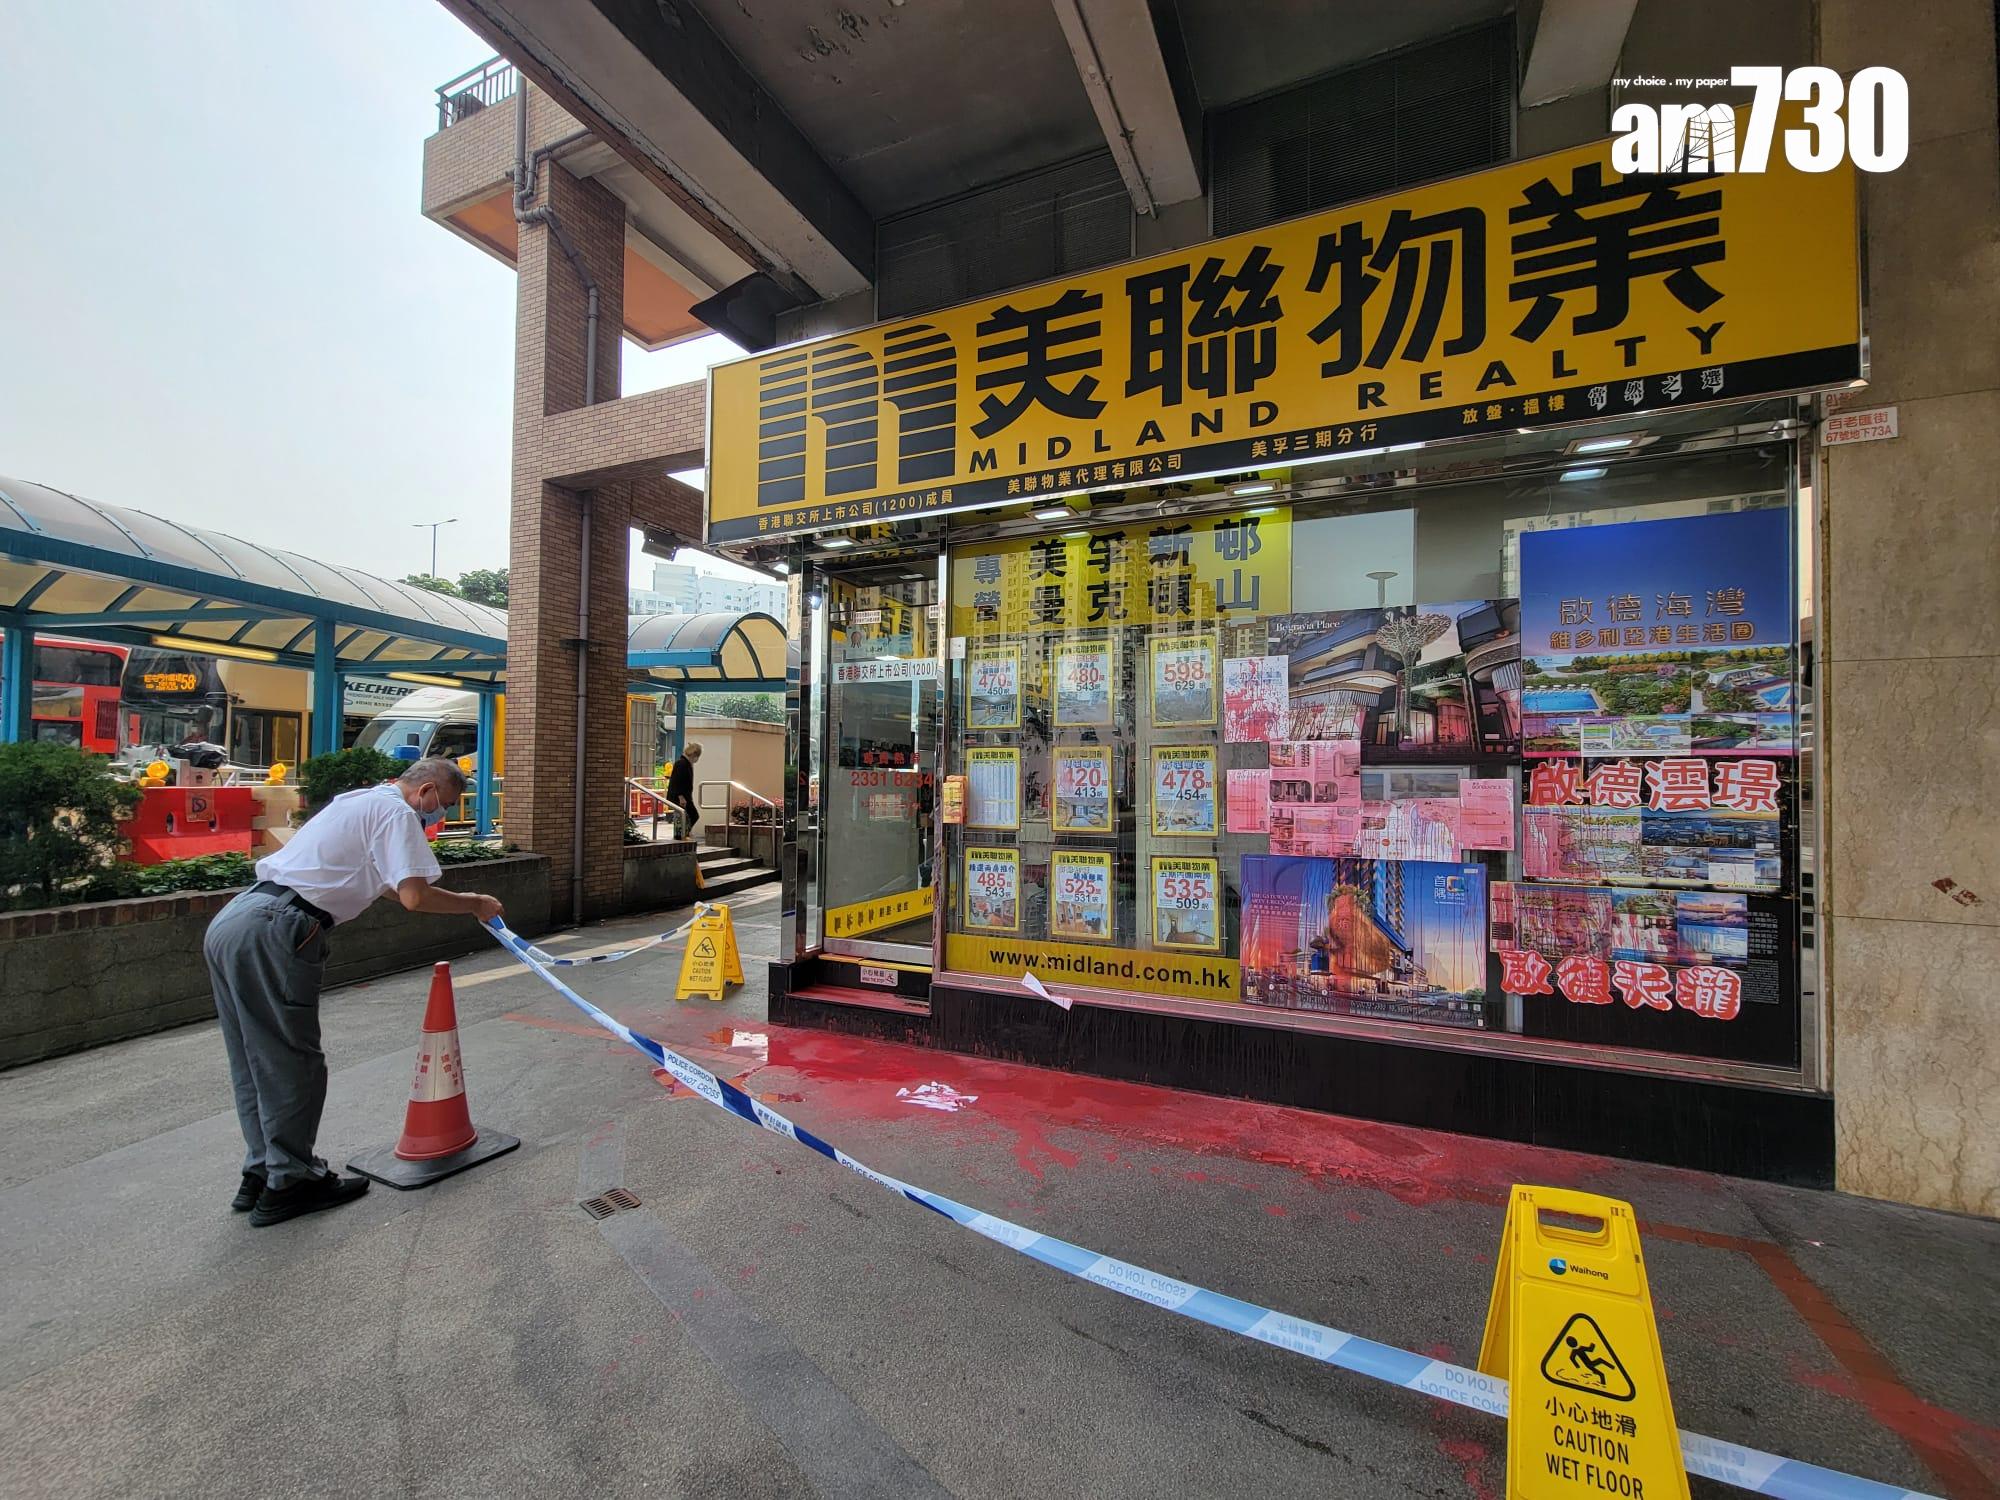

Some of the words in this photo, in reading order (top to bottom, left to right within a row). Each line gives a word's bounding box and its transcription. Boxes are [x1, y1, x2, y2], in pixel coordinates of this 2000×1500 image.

[970, 163, 1726, 440] 美聯物業
[969, 401, 1279, 474] MIDLAND
[1358, 321, 1726, 411] REALTY
[1588, 367, 1726, 411] 當然之選
[1826, 425, 1892, 442] 67號地下73A
[1829, 411, 1889, 430] 百老匯街
[1251, 423, 1379, 458] 美孚三期分行
[1007, 454, 1183, 495] 美聯物業代理有限公司
[758, 489, 954, 531] 香港聯交所上市公司(1200)成員
[1028, 517, 1261, 579] 美孚新邨
[973, 554, 1002, 622] 專營
[1028, 569, 1260, 626] 曼克頓山
[1560, 587, 1745, 625] 啟德海灣
[1550, 620, 1755, 650] 維多利亞港生活圈
[838, 662, 938, 681] 香港聯交所上市公司(1200)
[851, 771, 888, 787] 2331
[1075, 787, 1097, 798] 413
[1162, 769, 1206, 789] 478
[1530, 759, 1781, 812] 啟德澐璟
[977, 872, 1006, 888] 485
[1065, 878, 1096, 894] 525
[1164, 879, 1207, 899] 535
[1175, 898, 1200, 909] 509
[990, 949, 1232, 989] www.midland.com.hk
[667, 1054, 689, 1072] POLICE
[688, 1065, 714, 1084] CORDON
[683, 1074, 698, 1086] NOT
[697, 1083, 721, 1100] CROSS
[841, 1158, 868, 1180] POLICE
[1569, 1264, 1609, 1280] Waihong
[1545, 1396, 1637, 1438] 小心地滑
[1554, 1425, 1630, 1465] CAUTION
[1546, 1452, 1580, 1482] WET
[1586, 1464, 1644, 1500] FLOOR
